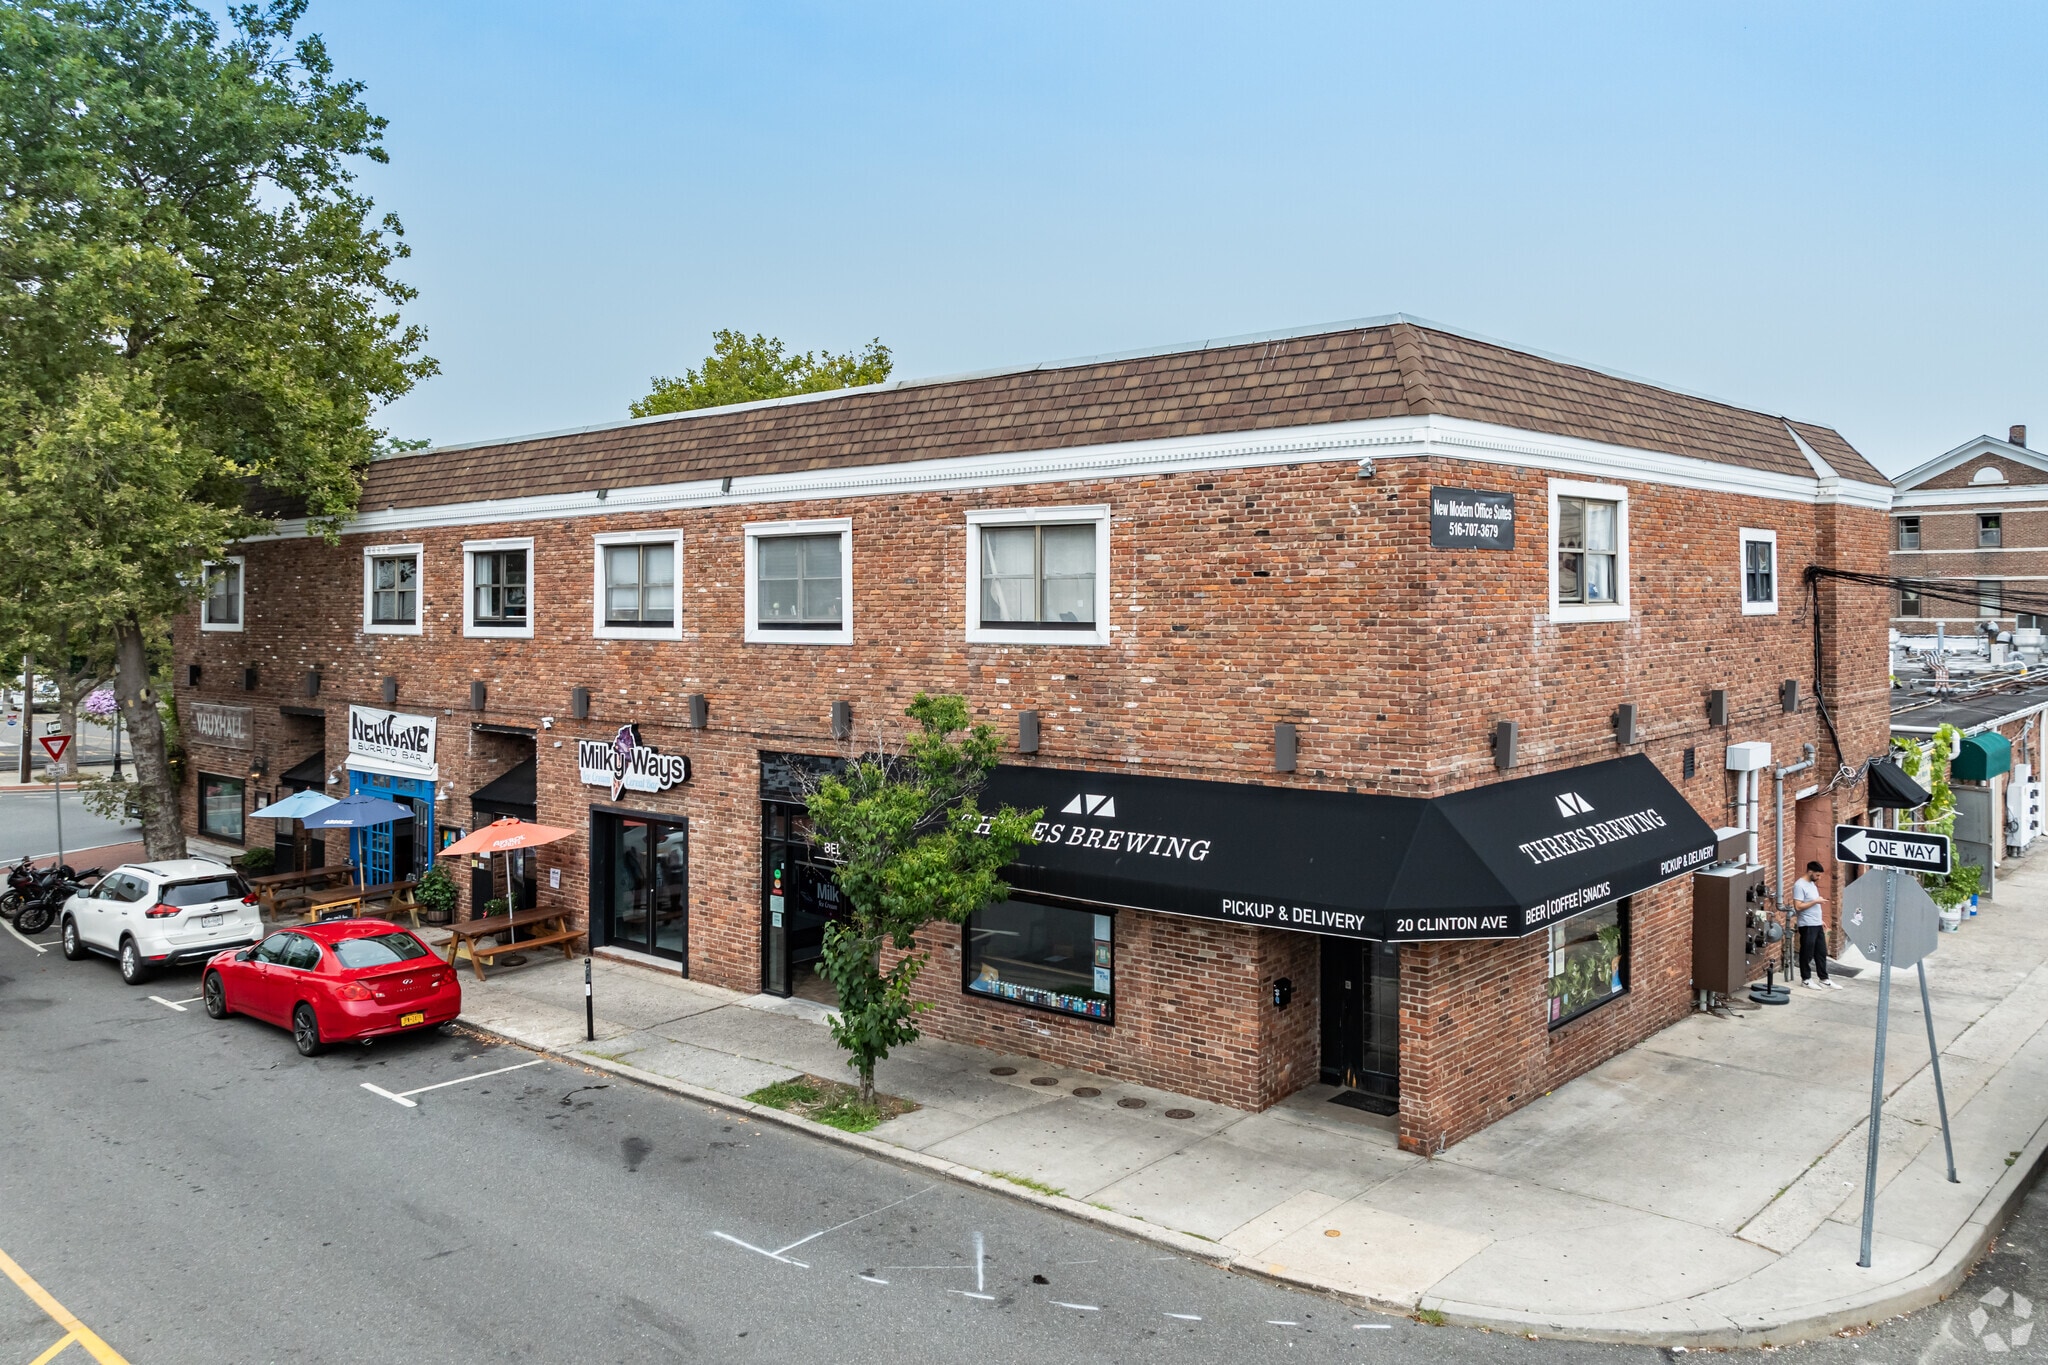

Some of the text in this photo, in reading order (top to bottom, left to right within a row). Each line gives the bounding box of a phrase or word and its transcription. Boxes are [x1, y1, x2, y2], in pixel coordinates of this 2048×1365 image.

[1434, 499, 1512, 521] New Modern Office Suites
[1449, 521, 1499, 538] 516-707-3679
[196, 712, 245, 739] VAUXHALL
[358, 742, 423, 762] BURRITO BAR
[580, 743, 683, 786] Milky Ways
[1065, 826, 1211, 862] BREWING
[1518, 808, 1667, 864] THREES BREWING
[1868, 840, 1935, 860] ONE WAY
[1660, 844, 1715, 876] PICKUP & DELIVERY
[1222, 898, 1365, 931] PICKUP & DELIVERY
[1525, 881, 1611, 925] BEER COFFEE SNACKS
[1396, 915, 1508, 932] 20 CLINTON AVE
